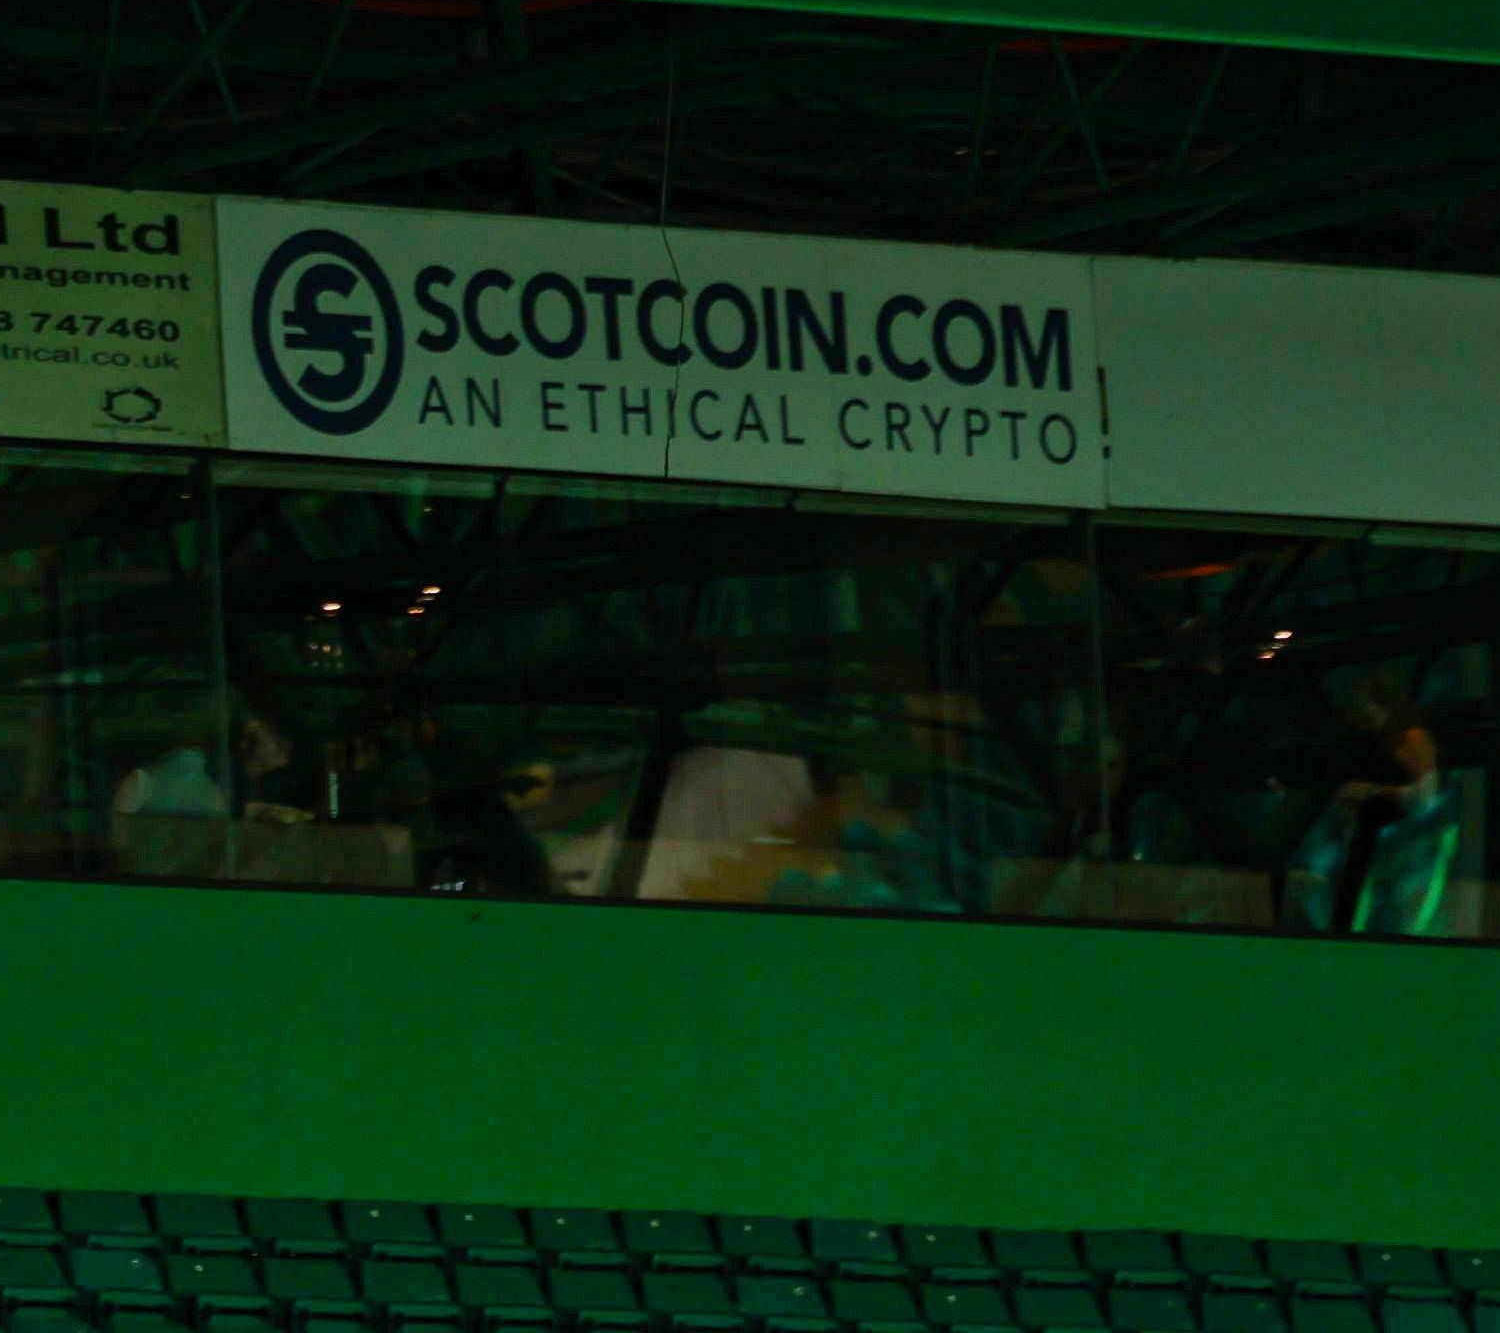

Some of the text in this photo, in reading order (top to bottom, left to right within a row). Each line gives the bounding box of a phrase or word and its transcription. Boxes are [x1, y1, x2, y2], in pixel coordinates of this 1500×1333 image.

[43, 205, 182, 257] Ltd
[30, 312, 181, 343] 747460
[413, 264, 1073, 393] SCOTCOIN.COM
[418, 375, 1079, 465] AN ETHICAL CRYPTO
